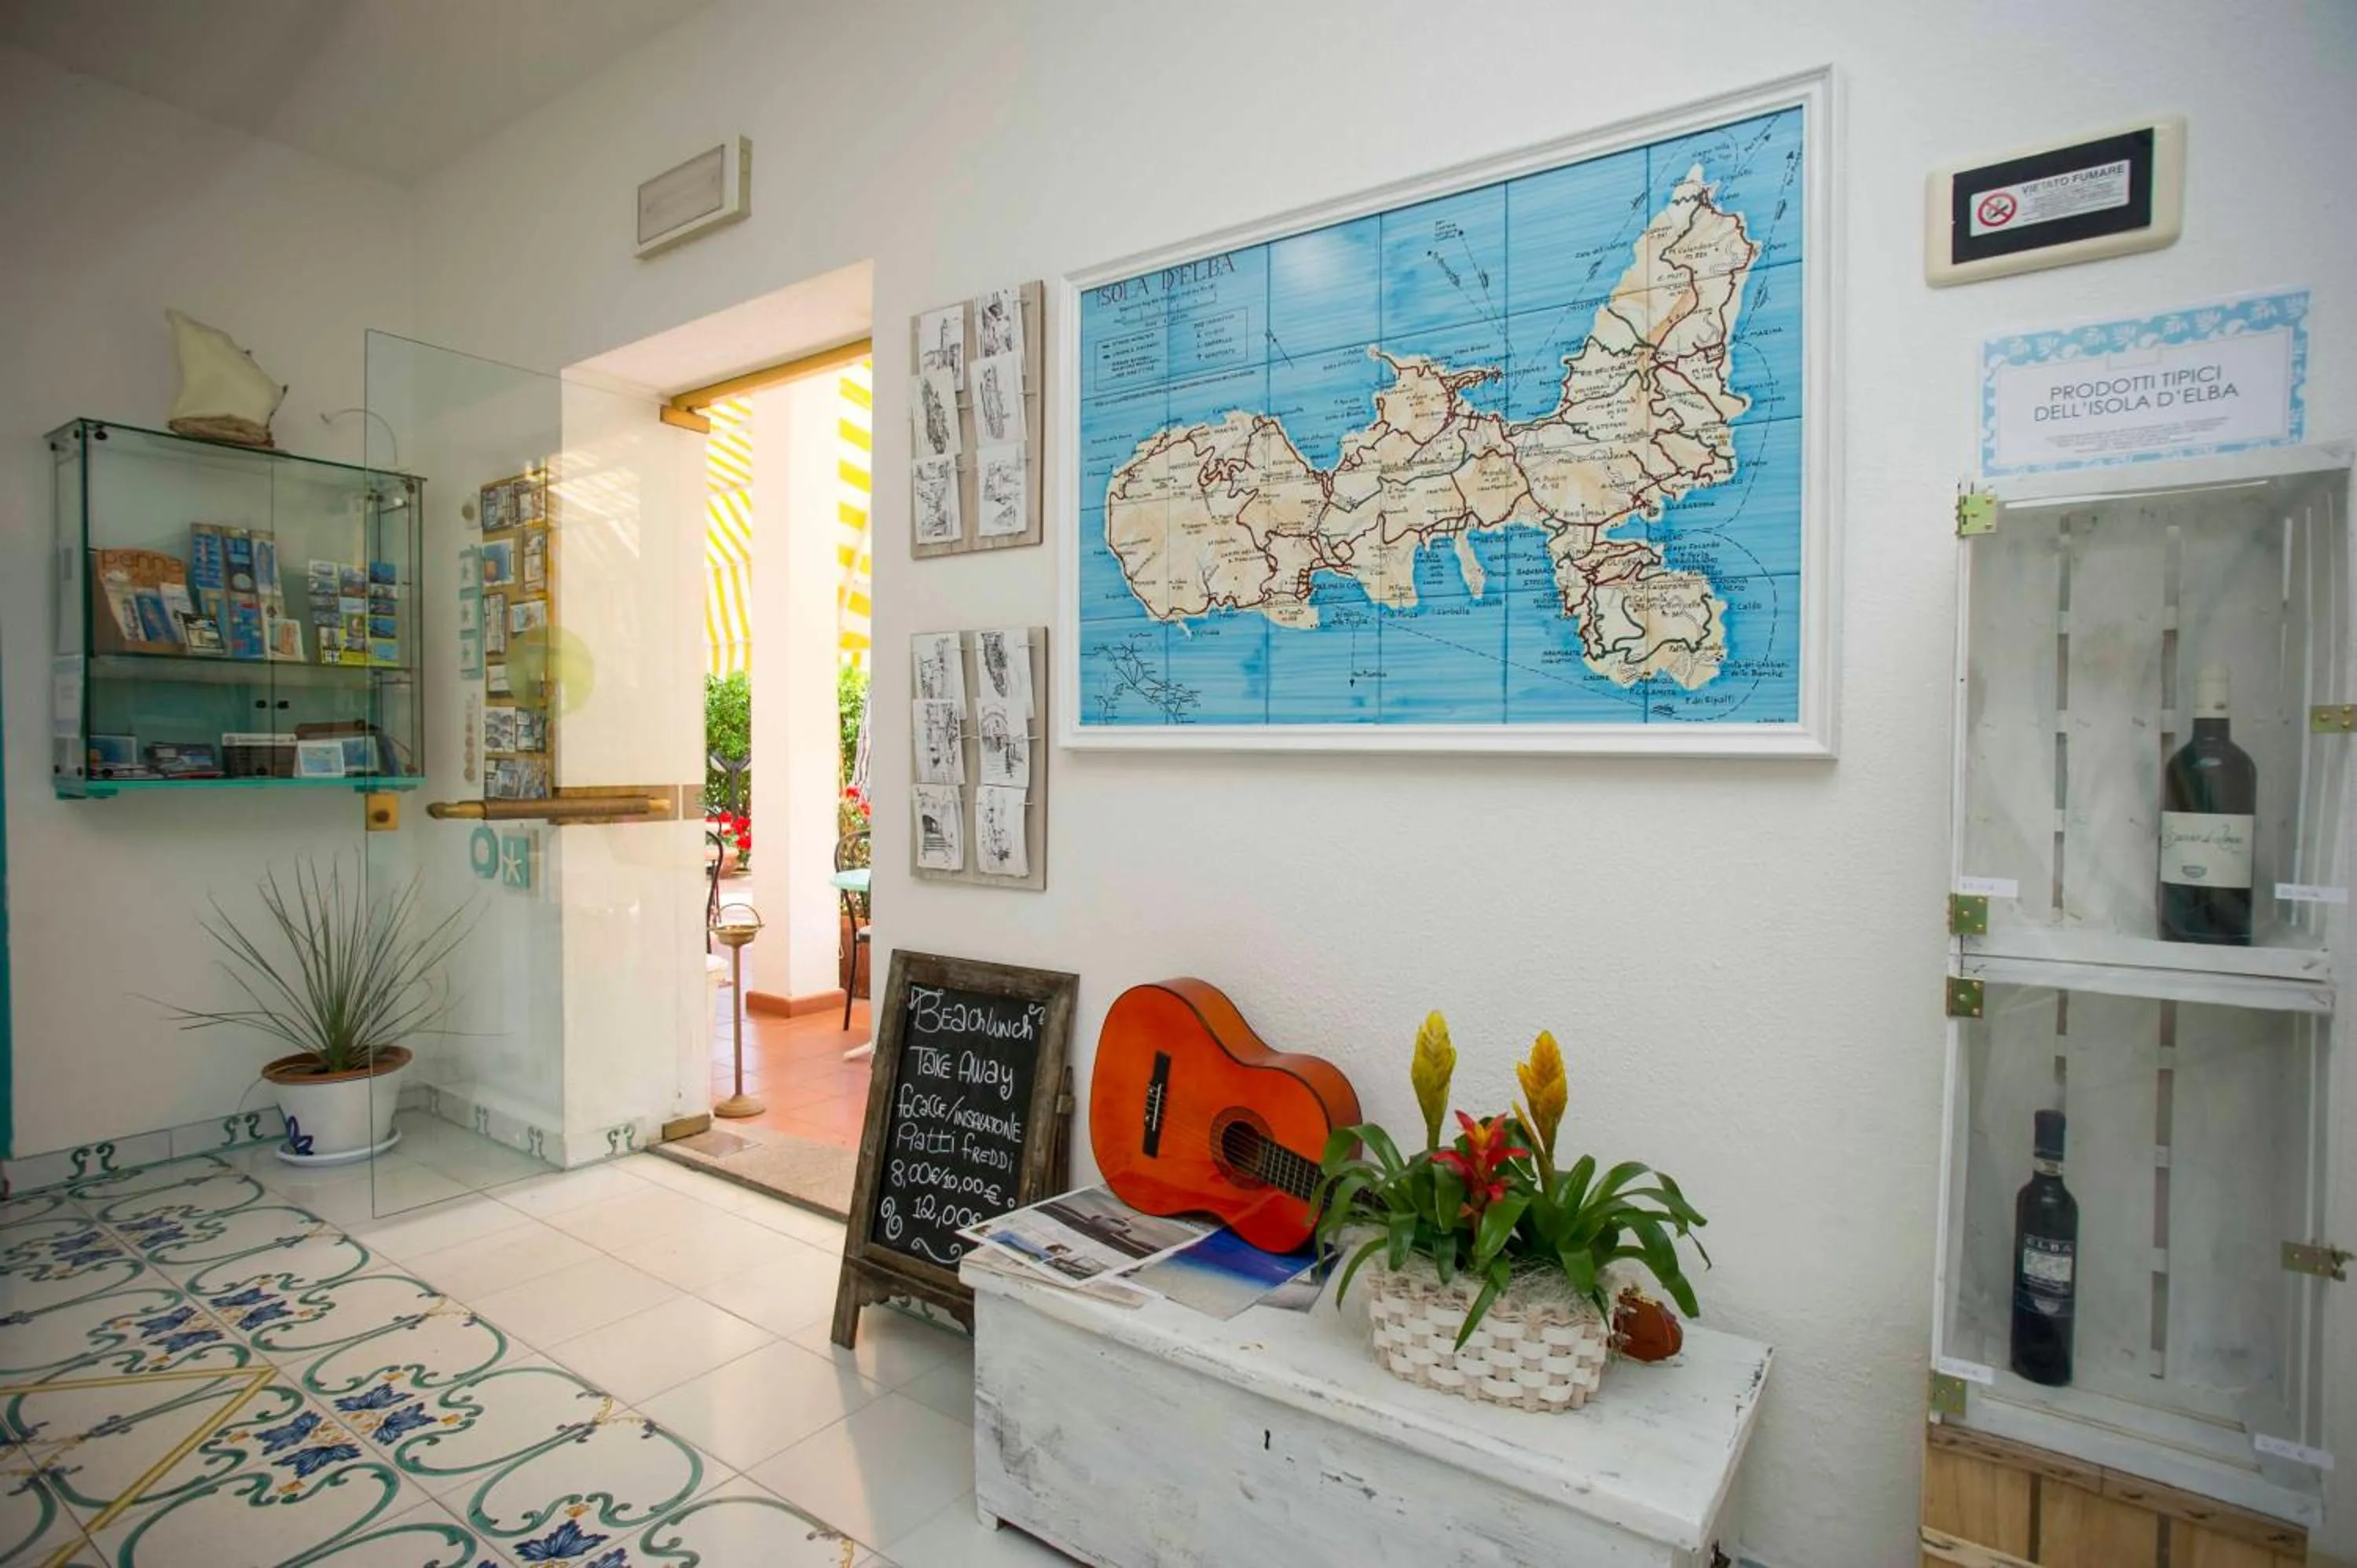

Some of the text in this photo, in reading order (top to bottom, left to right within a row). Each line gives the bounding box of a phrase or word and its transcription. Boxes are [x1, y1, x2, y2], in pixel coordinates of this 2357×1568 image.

[2072, 163, 2125, 182] FUMARE
[2050, 365, 2222, 401] PRODOTTI TIPICI
[2034, 383, 2239, 423] DELL'ISOLA D'ELBA
[896, 1122, 956, 1154] Piatti
